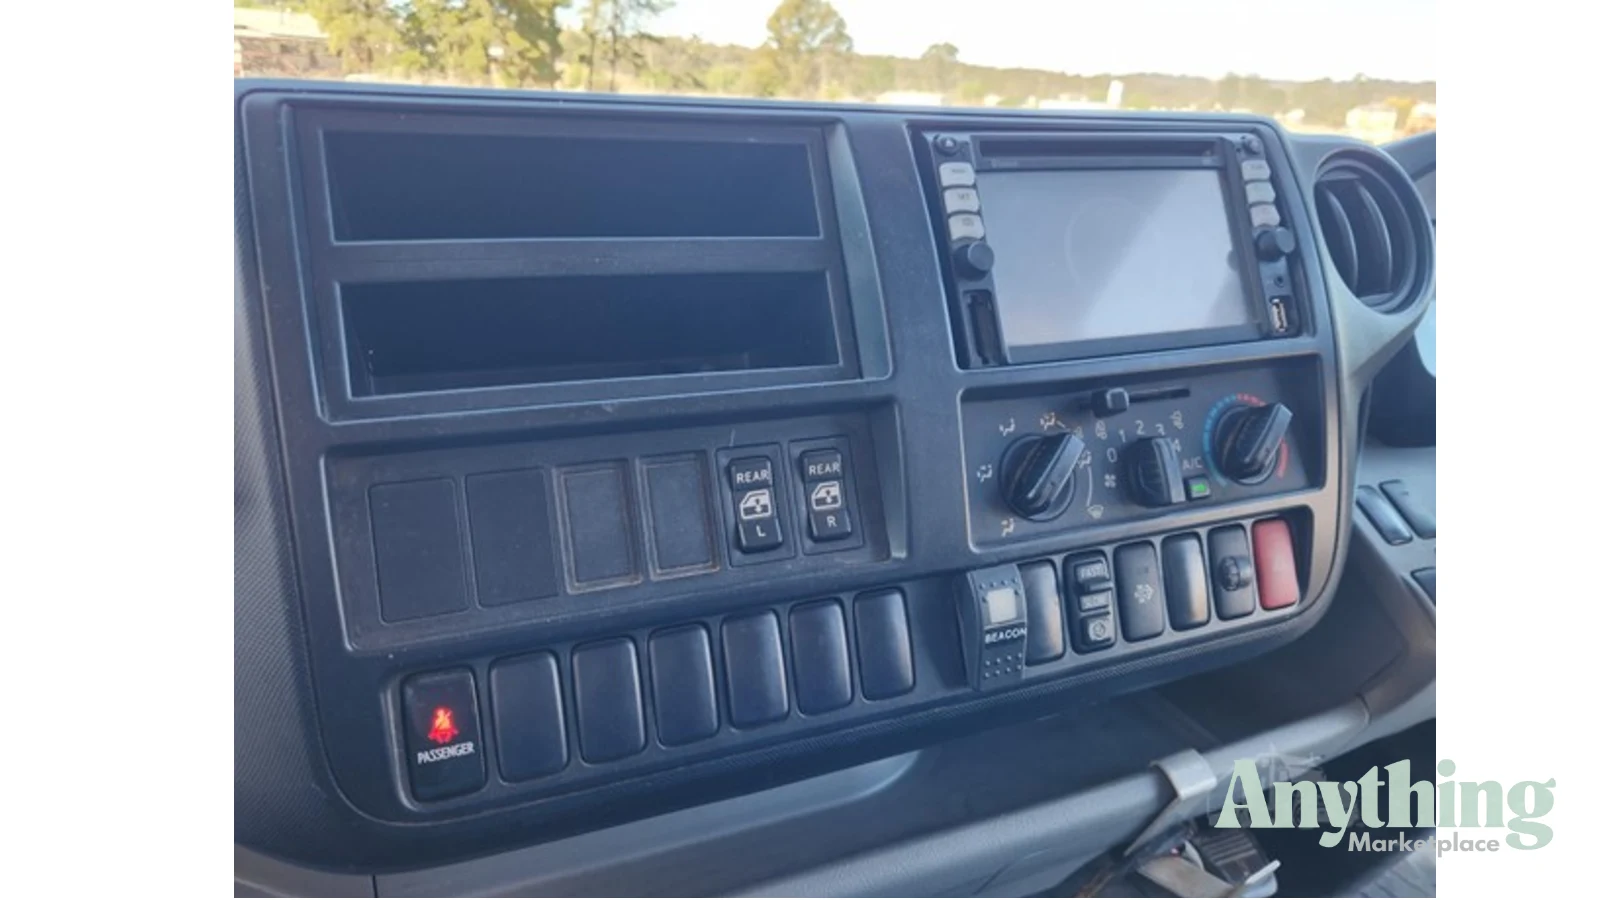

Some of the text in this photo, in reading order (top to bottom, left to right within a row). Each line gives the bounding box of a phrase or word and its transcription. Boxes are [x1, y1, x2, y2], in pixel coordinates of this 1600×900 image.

[1118, 428, 1126, 443] 1
[1135, 420, 1146, 435] 2
[809, 462, 841, 475] REAR
[1182, 456, 1203, 470] A/C
[736, 469, 770, 484] REAR
[826, 515, 838, 527] R
[756, 525, 766, 537] L
[985, 627, 1027, 644] BEACON
[417, 741, 475, 764] PASSENGER
